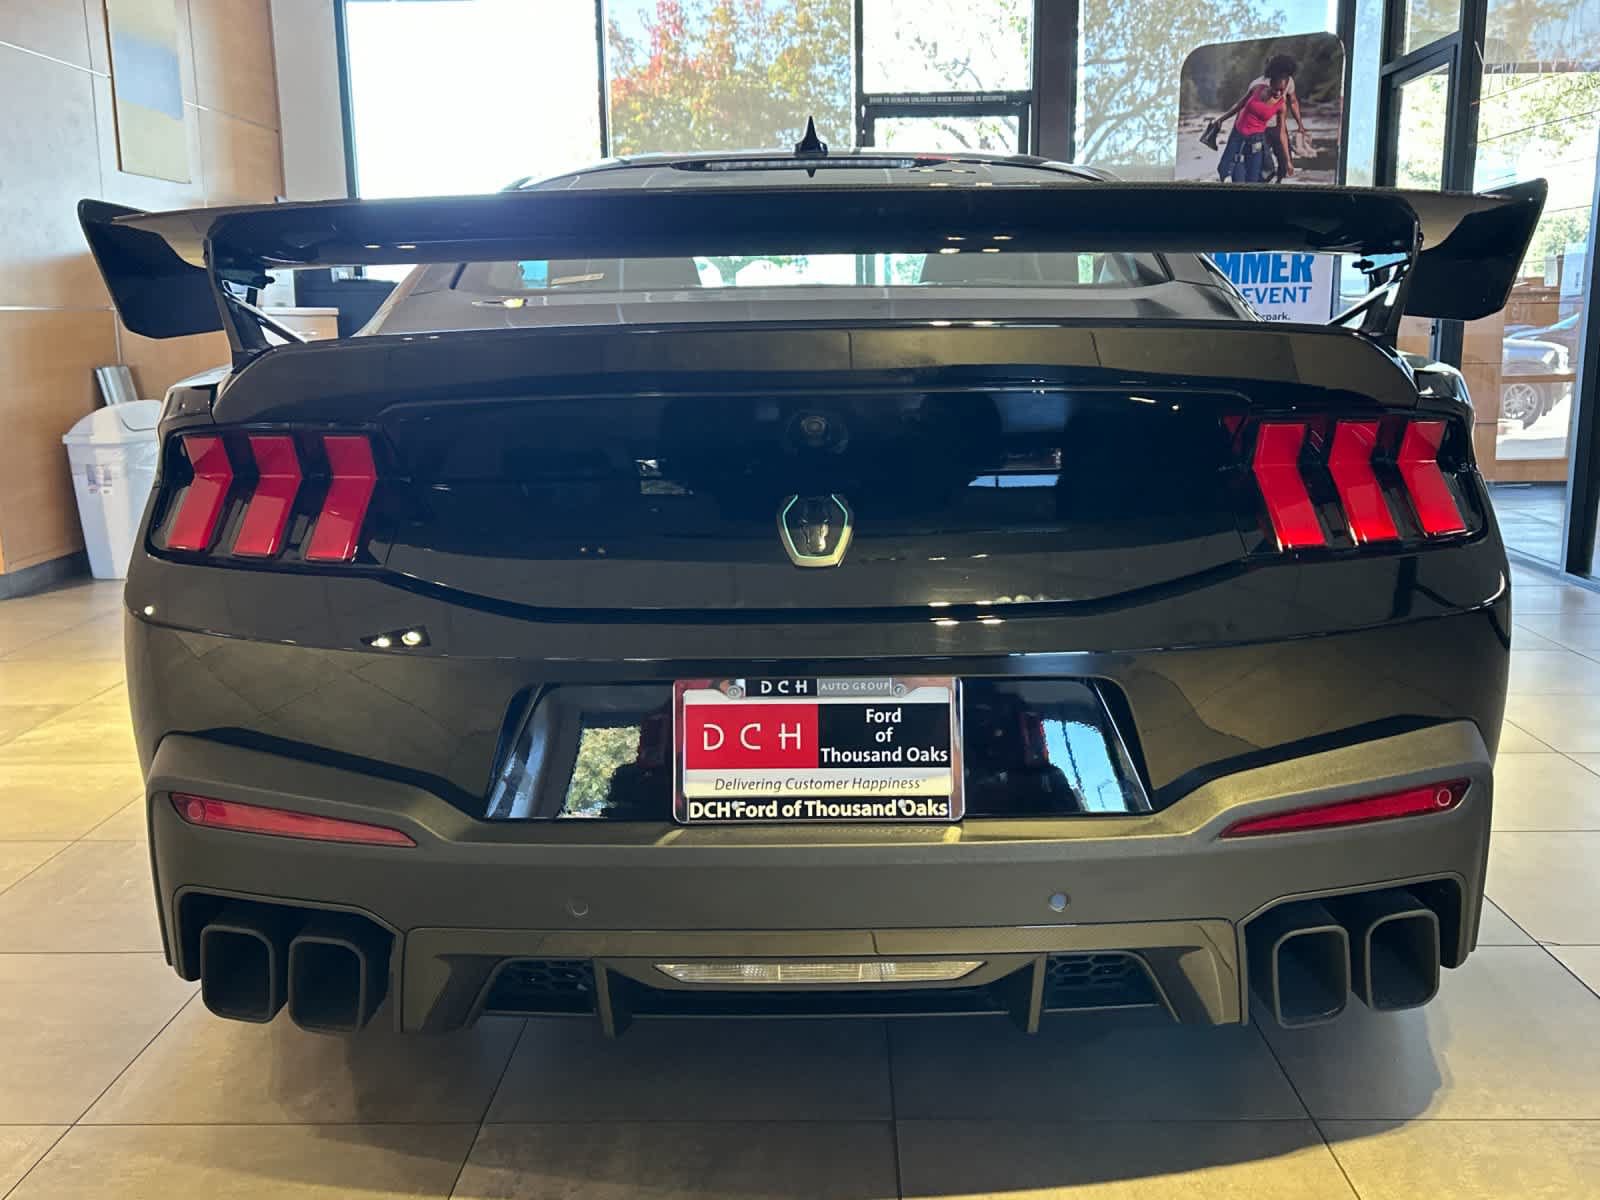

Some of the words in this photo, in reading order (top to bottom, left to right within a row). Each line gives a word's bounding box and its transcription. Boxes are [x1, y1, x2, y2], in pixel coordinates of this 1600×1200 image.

[1207, 253, 1315, 284] MMER
[1242, 286, 1312, 304] EVENT
[761, 680, 808, 694] DCH
[820, 682, 850, 691] AUTO
[852, 681, 889, 691] GROUP
[865, 708, 901, 724] Ford
[703, 723, 801, 750] DCH
[875, 727, 894, 742] of
[820, 747, 902, 763] Thousand
[906, 746, 948, 762] Oaks
[714, 777, 781, 792] Delivering
[785, 777, 848, 791] Customer
[851, 776, 921, 792] Happiness
[689, 801, 731, 818] DCH
[735, 800, 778, 817] Ford
[782, 800, 802, 817] of
[804, 799, 897, 817] Thousand
[901, 798, 948, 816] Oaks
